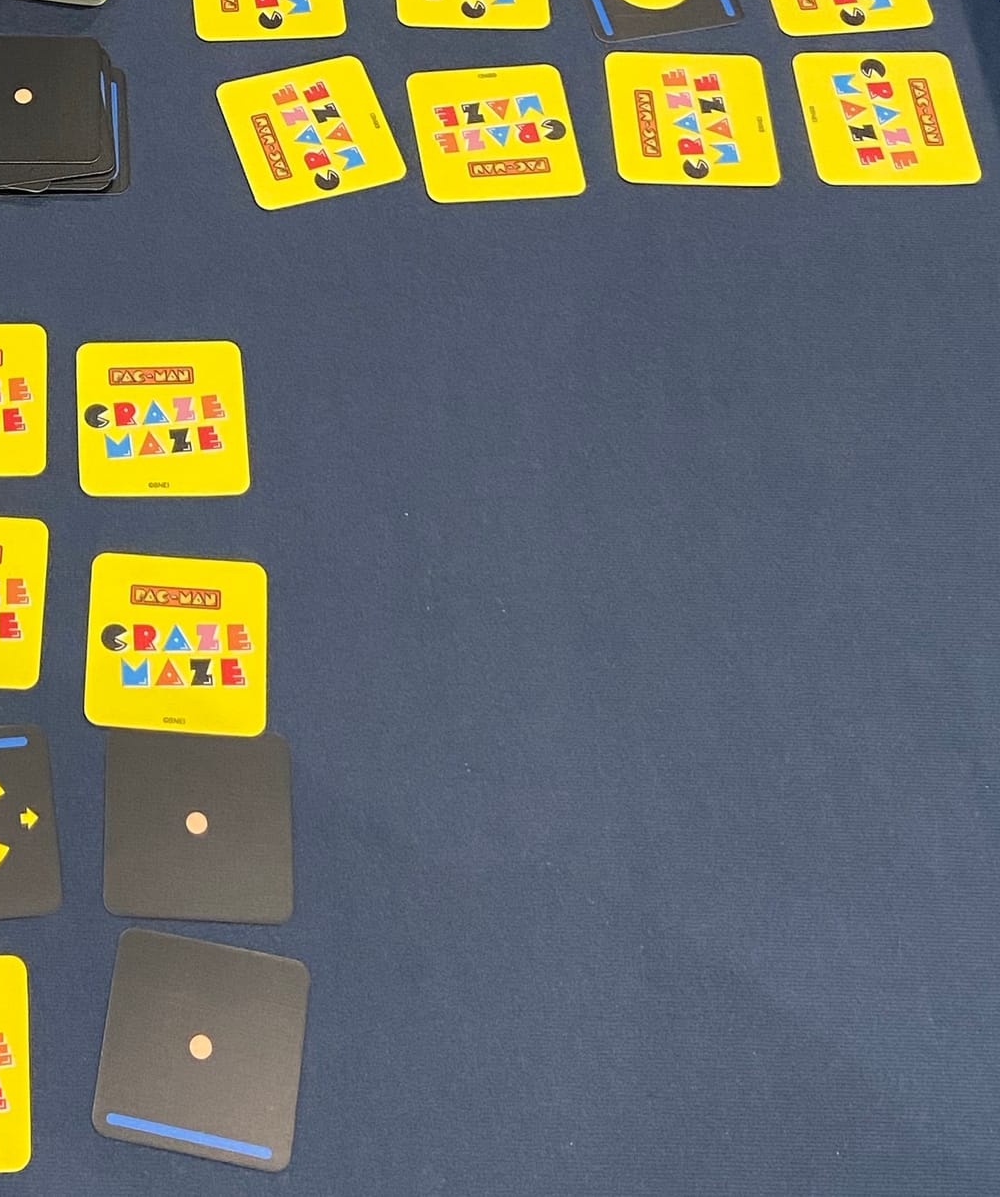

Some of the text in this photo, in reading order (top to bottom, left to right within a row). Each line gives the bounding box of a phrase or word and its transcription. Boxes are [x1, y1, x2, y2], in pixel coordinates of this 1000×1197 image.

[831, 73, 885, 168] MAZE
[860, 59, 919, 170] CRAZE
[909, 79, 943, 145] PAC-MAN
